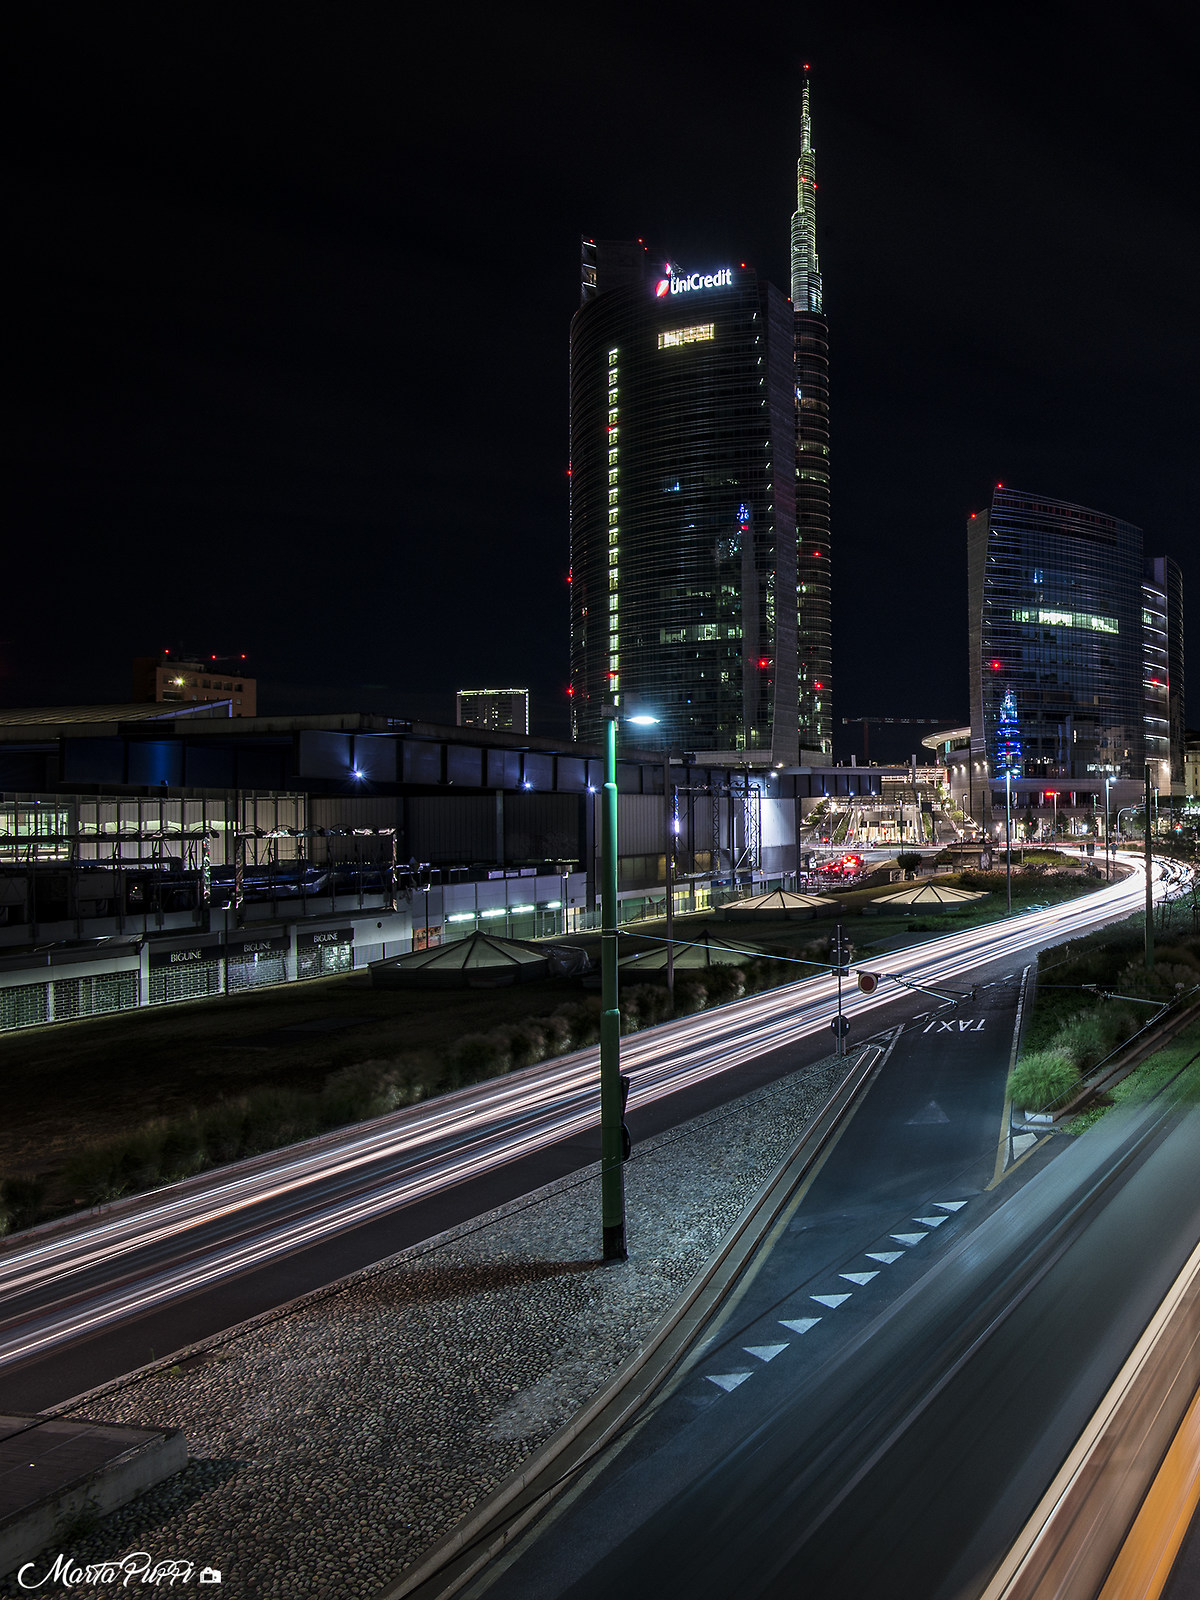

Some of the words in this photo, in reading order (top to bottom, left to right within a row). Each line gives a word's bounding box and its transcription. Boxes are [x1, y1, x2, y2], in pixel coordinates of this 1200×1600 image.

[670, 269, 732, 295] UniCredit
[313, 932, 338, 943] BIGUINE
[243, 941, 271, 952] BIGUINE
[170, 950, 202, 962] BIGUINE
[922, 1018, 986, 1034] TAXI
